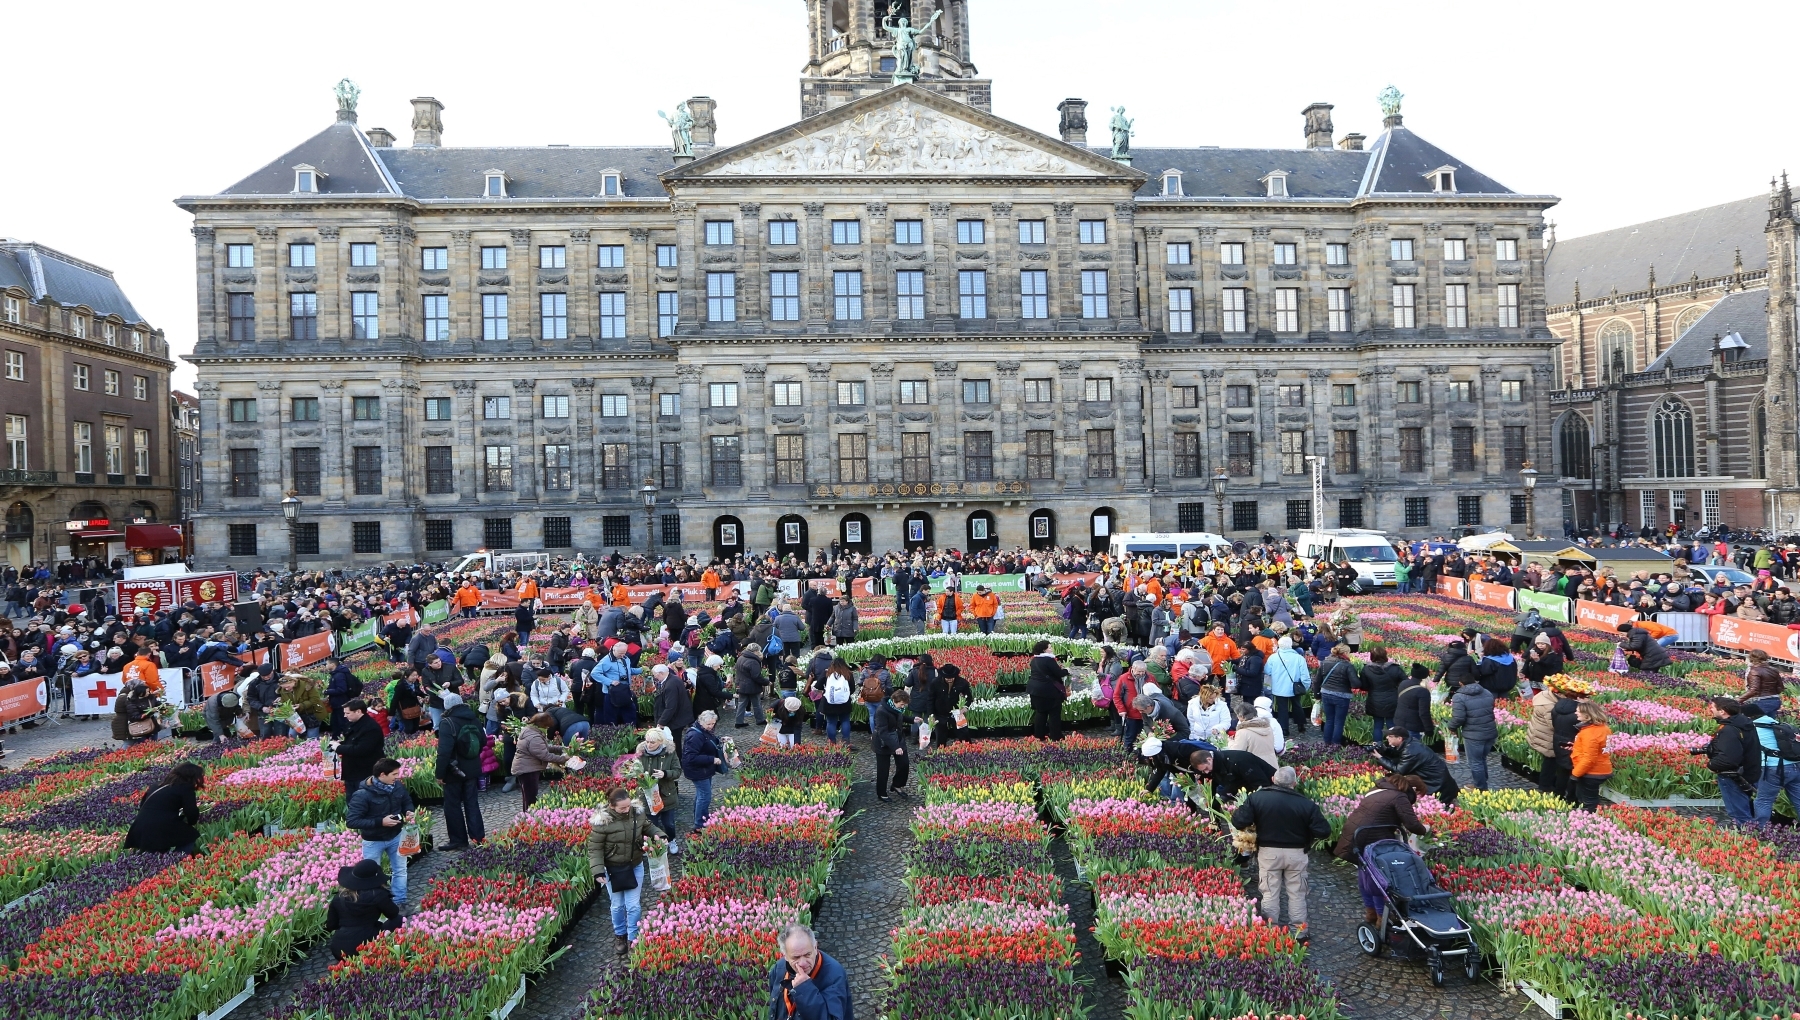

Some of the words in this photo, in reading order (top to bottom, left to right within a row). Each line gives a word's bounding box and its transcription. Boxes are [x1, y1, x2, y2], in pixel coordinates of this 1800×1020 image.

[123, 581, 166, 589] HOTDOGS
[998, 579, 1015, 587] own!
[544, 592, 561, 600] Pluk
[1580, 607, 1597, 620] Pluk
